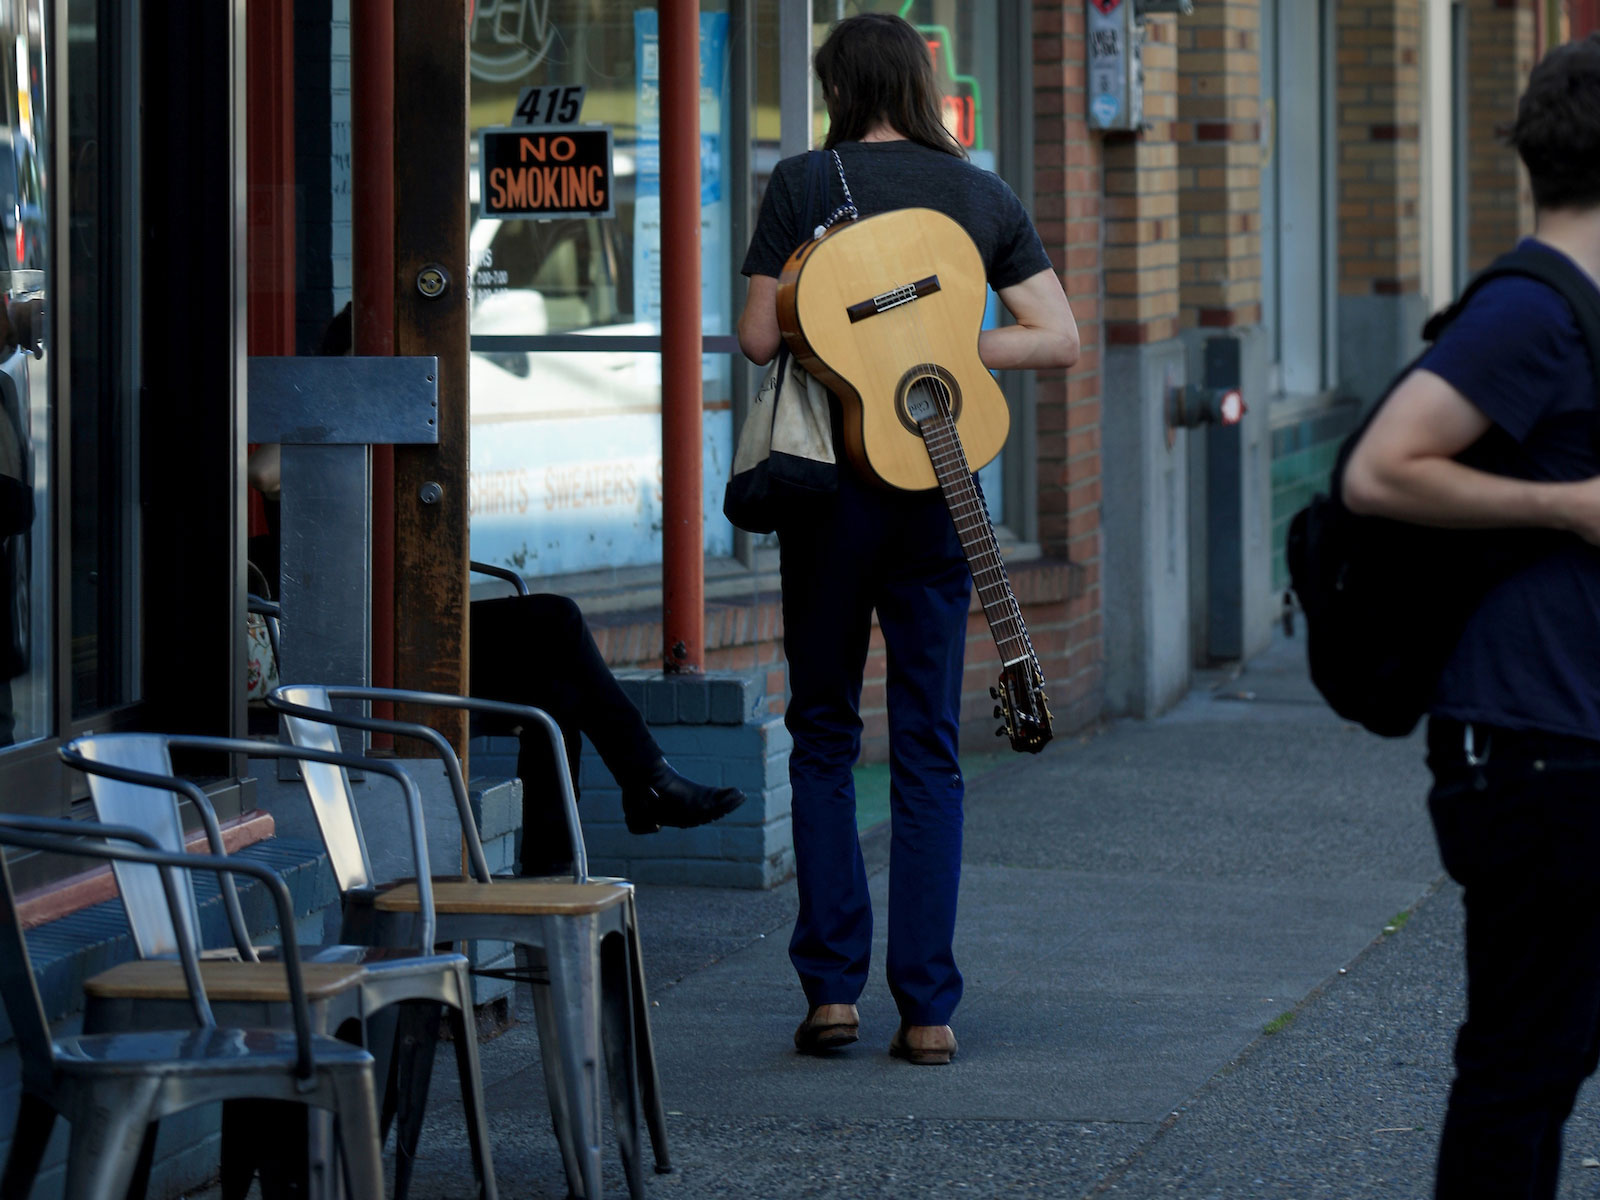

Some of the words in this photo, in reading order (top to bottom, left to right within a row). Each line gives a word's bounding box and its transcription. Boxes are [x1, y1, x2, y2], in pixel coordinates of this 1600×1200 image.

[516, 86, 582, 126] 415
[519, 136, 577, 162] NO
[489, 164, 604, 209] SMOKING
[544, 461, 637, 511] SWEATERS
